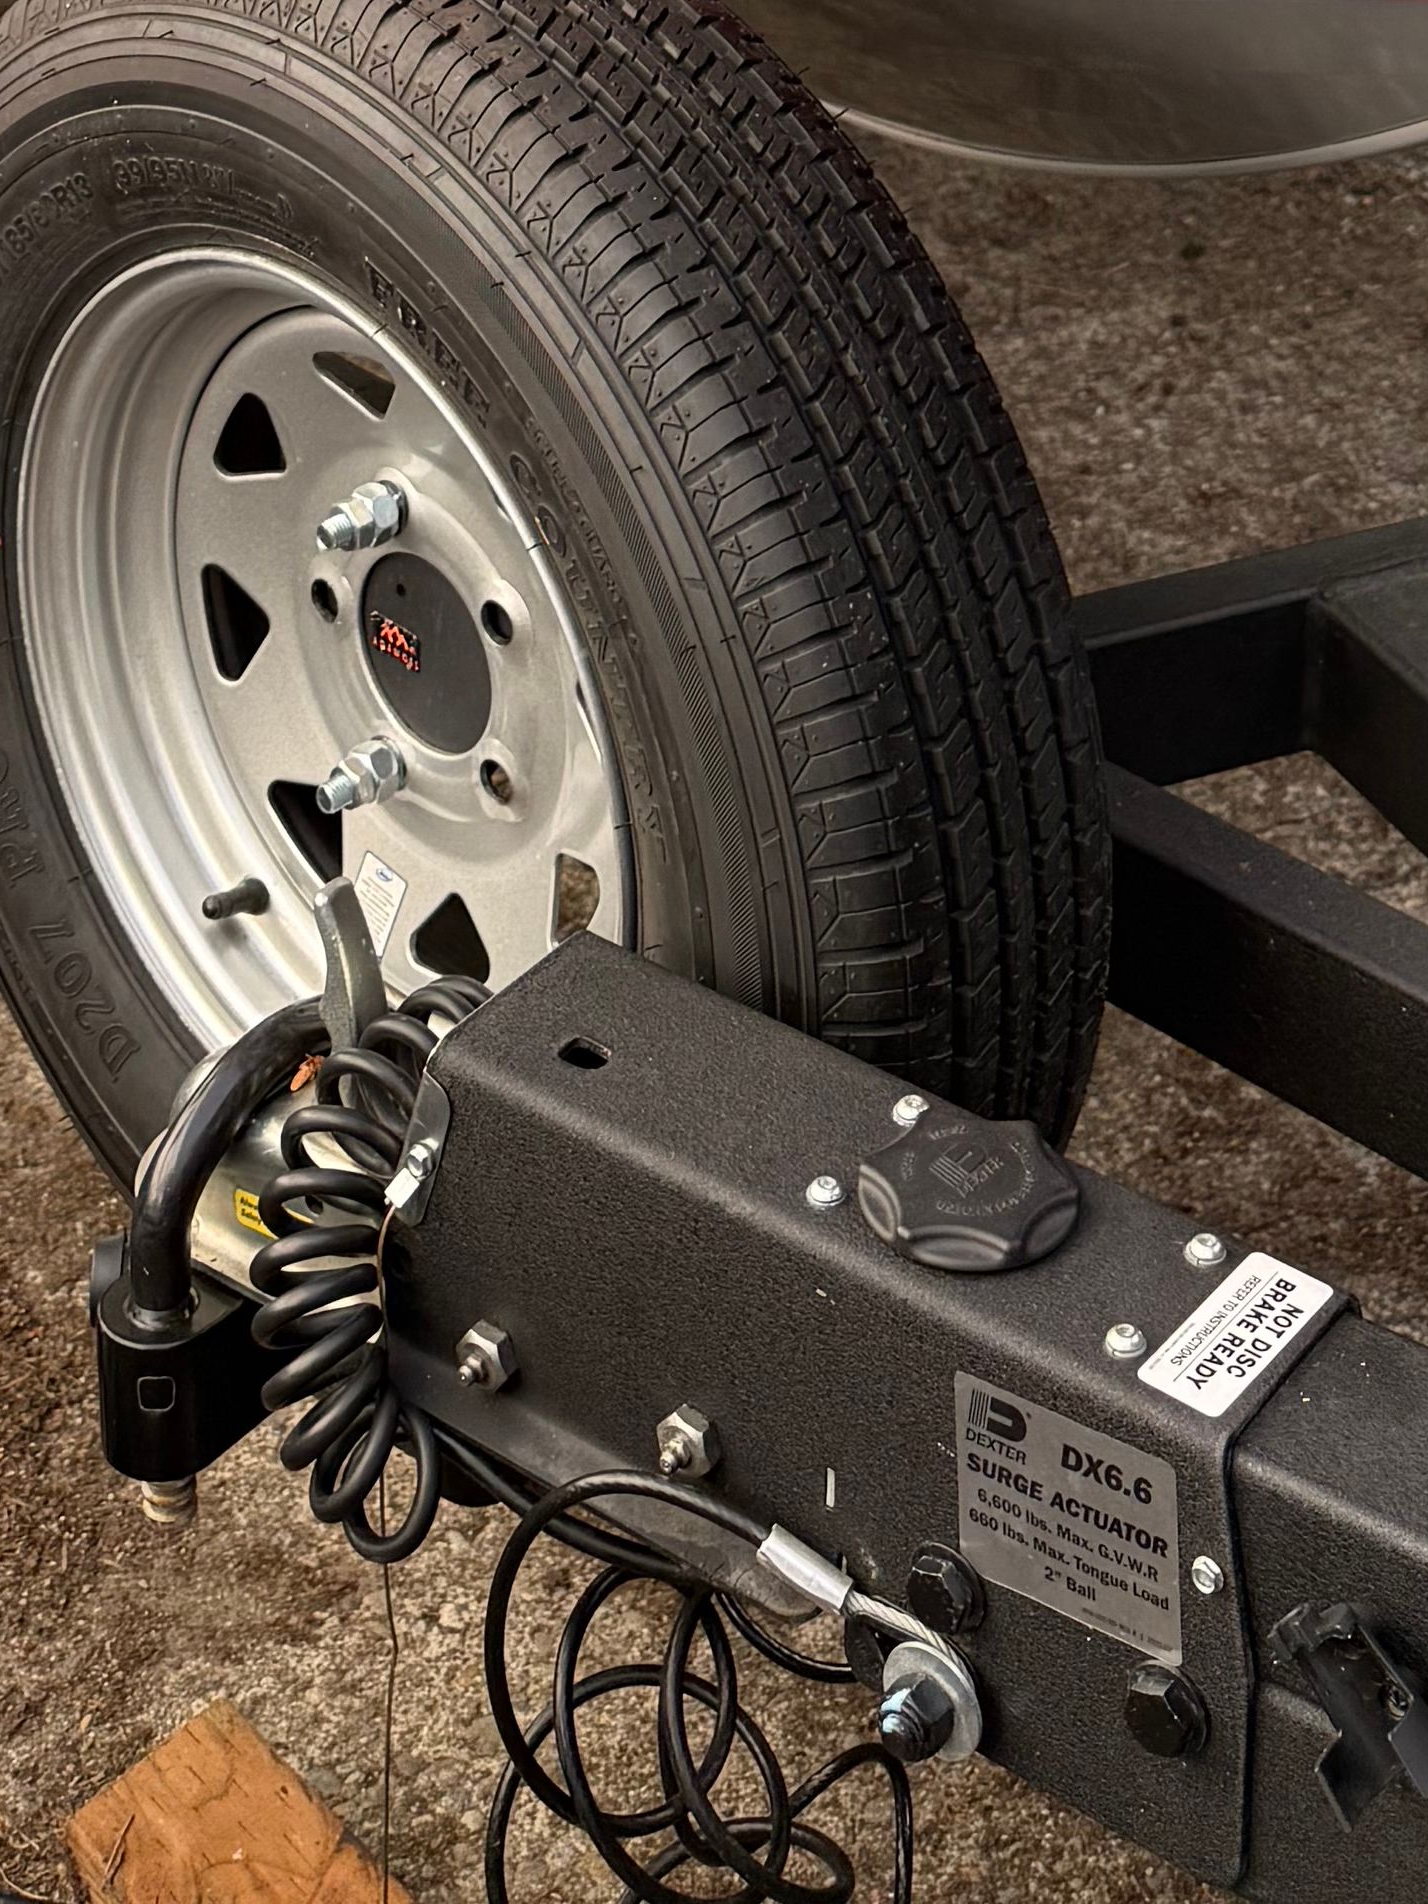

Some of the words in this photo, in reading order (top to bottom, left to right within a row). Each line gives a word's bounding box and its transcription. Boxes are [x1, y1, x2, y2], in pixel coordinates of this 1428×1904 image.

[1222, 1299, 1237, 1313] TO
[1232, 1274, 1262, 1301] REFER
[1236, 1277, 1297, 1334] BRAKE
[1170, 1310, 1227, 1367] INSTRUCTIONS
[1265, 1303, 1305, 1339] NOT
[1185, 1331, 1246, 1390] READY
[1226, 1338, 1273, 1379] DISC
[965, 1426, 1027, 1466] DEXTER
[1060, 1443, 1153, 1505] DX6.6
[966, 1452, 1044, 1502] SURGE
[1049, 1491, 1169, 1559] ACTUATOR
[968, 1507, 999, 1532] 660
[1001, 1522, 1029, 1547] lbs.
[1032, 1536, 1071, 1567] Max.
[1072, 1555, 1130, 1592] Tongue
[1131, 1581, 1170, 1612] Load
[977, 1487, 1022, 1519] 6,600
[1025, 1510, 1052, 1535] lbs.
[1056, 1524, 1094, 1554] Max.
[1098, 1543, 1159, 1583] G.V.W.R
[1066, 1576, 1097, 1602] Ball
